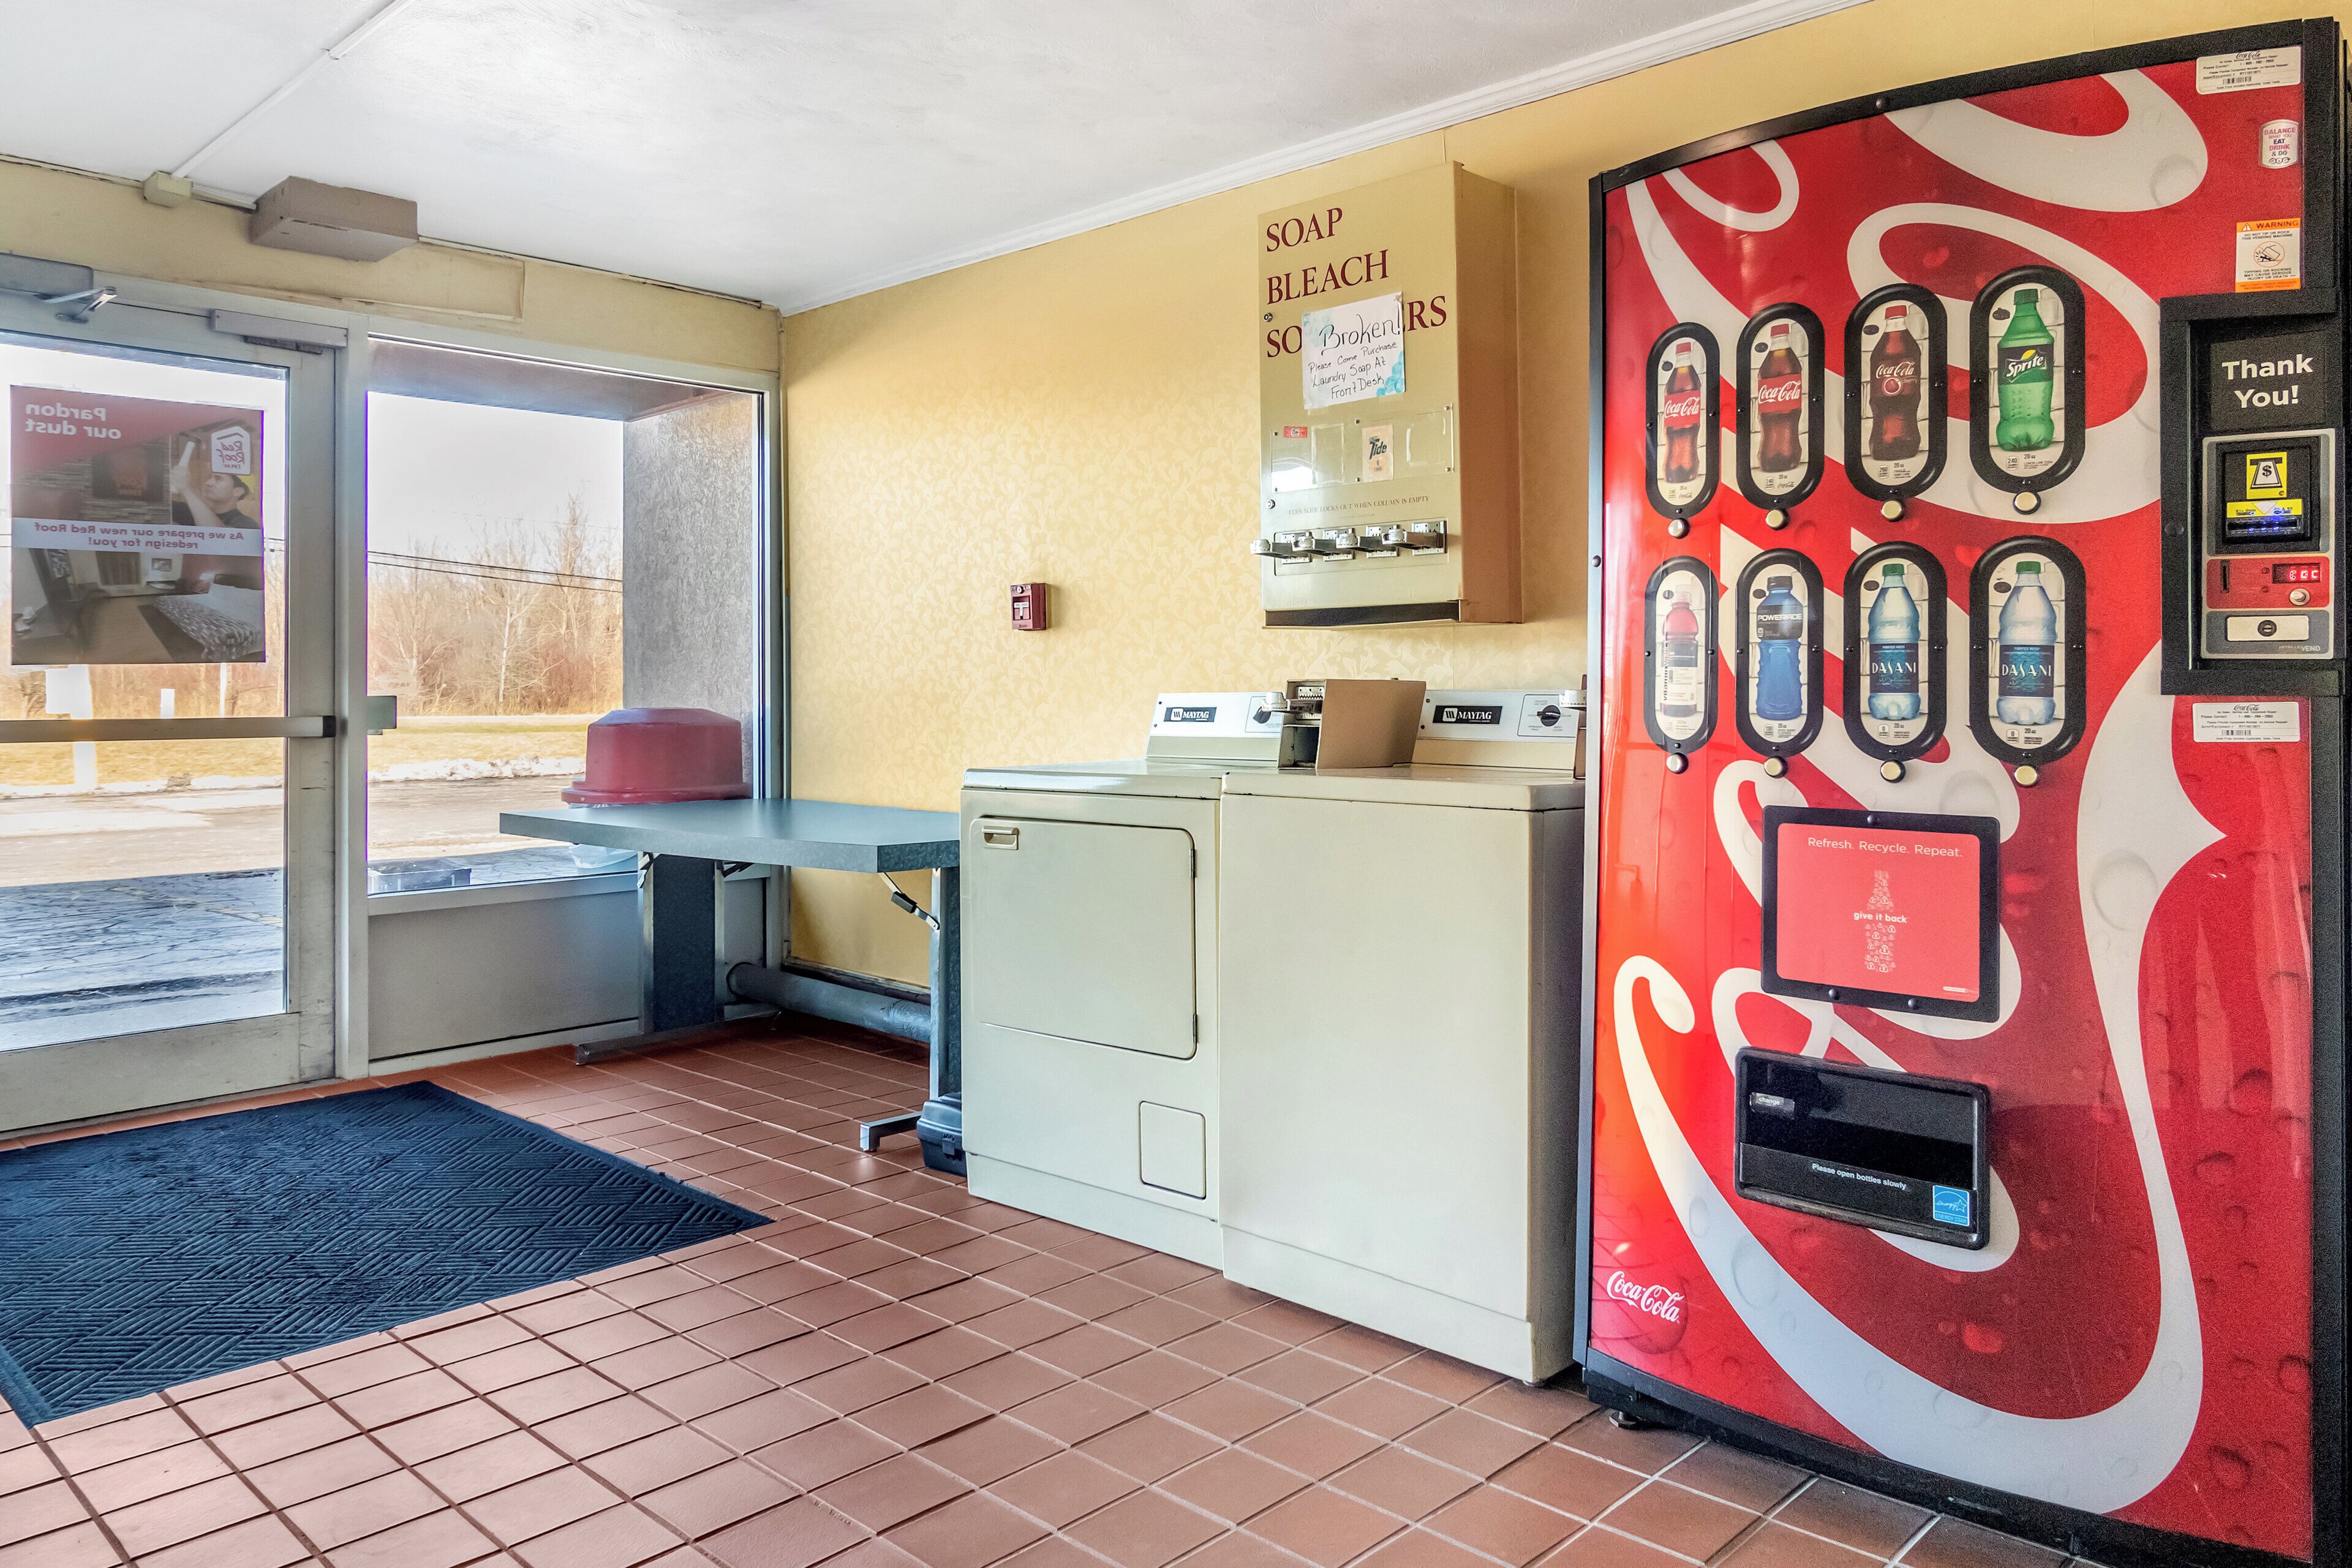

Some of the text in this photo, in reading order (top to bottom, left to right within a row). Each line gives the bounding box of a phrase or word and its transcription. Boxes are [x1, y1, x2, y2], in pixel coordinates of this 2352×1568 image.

[1266, 207, 1343, 252] SOAP
[1266, 249, 1389, 305] BLEACH
[1319, 303, 1400, 356] Broken!
[1308, 342, 1398, 374] Please Come Purchase
[2008, 356, 2045, 377] Sprite
[2222, 354, 2313, 380] Thank
[1313, 371, 1346, 387] Laundry
[1349, 364, 1371, 376] Soap
[1876, 361, 1915, 379] Coca-Cola
[1331, 373, 1384, 399] Front Desk
[1758, 380, 1801, 404] Coca-Cola
[2234, 385, 2299, 409] You!
[1664, 397, 1700, 418] Coca-Cola
[1369, 439, 1387, 460] Tide
[1373, 499, 1400, 507] COLUMN
[1872, 658, 1916, 674] DASANI
[2002, 661, 2051, 677] DASANI
[1808, 837, 1963, 858] Refresh. Recycle. Repeat.
[1853, 911, 1907, 924] give it back
[1758, 1096, 1781, 1106] change
[1812, 1163, 1907, 1191] Please open bottles slowly
[1607, 1271, 1685, 1323] Coca-Cola
